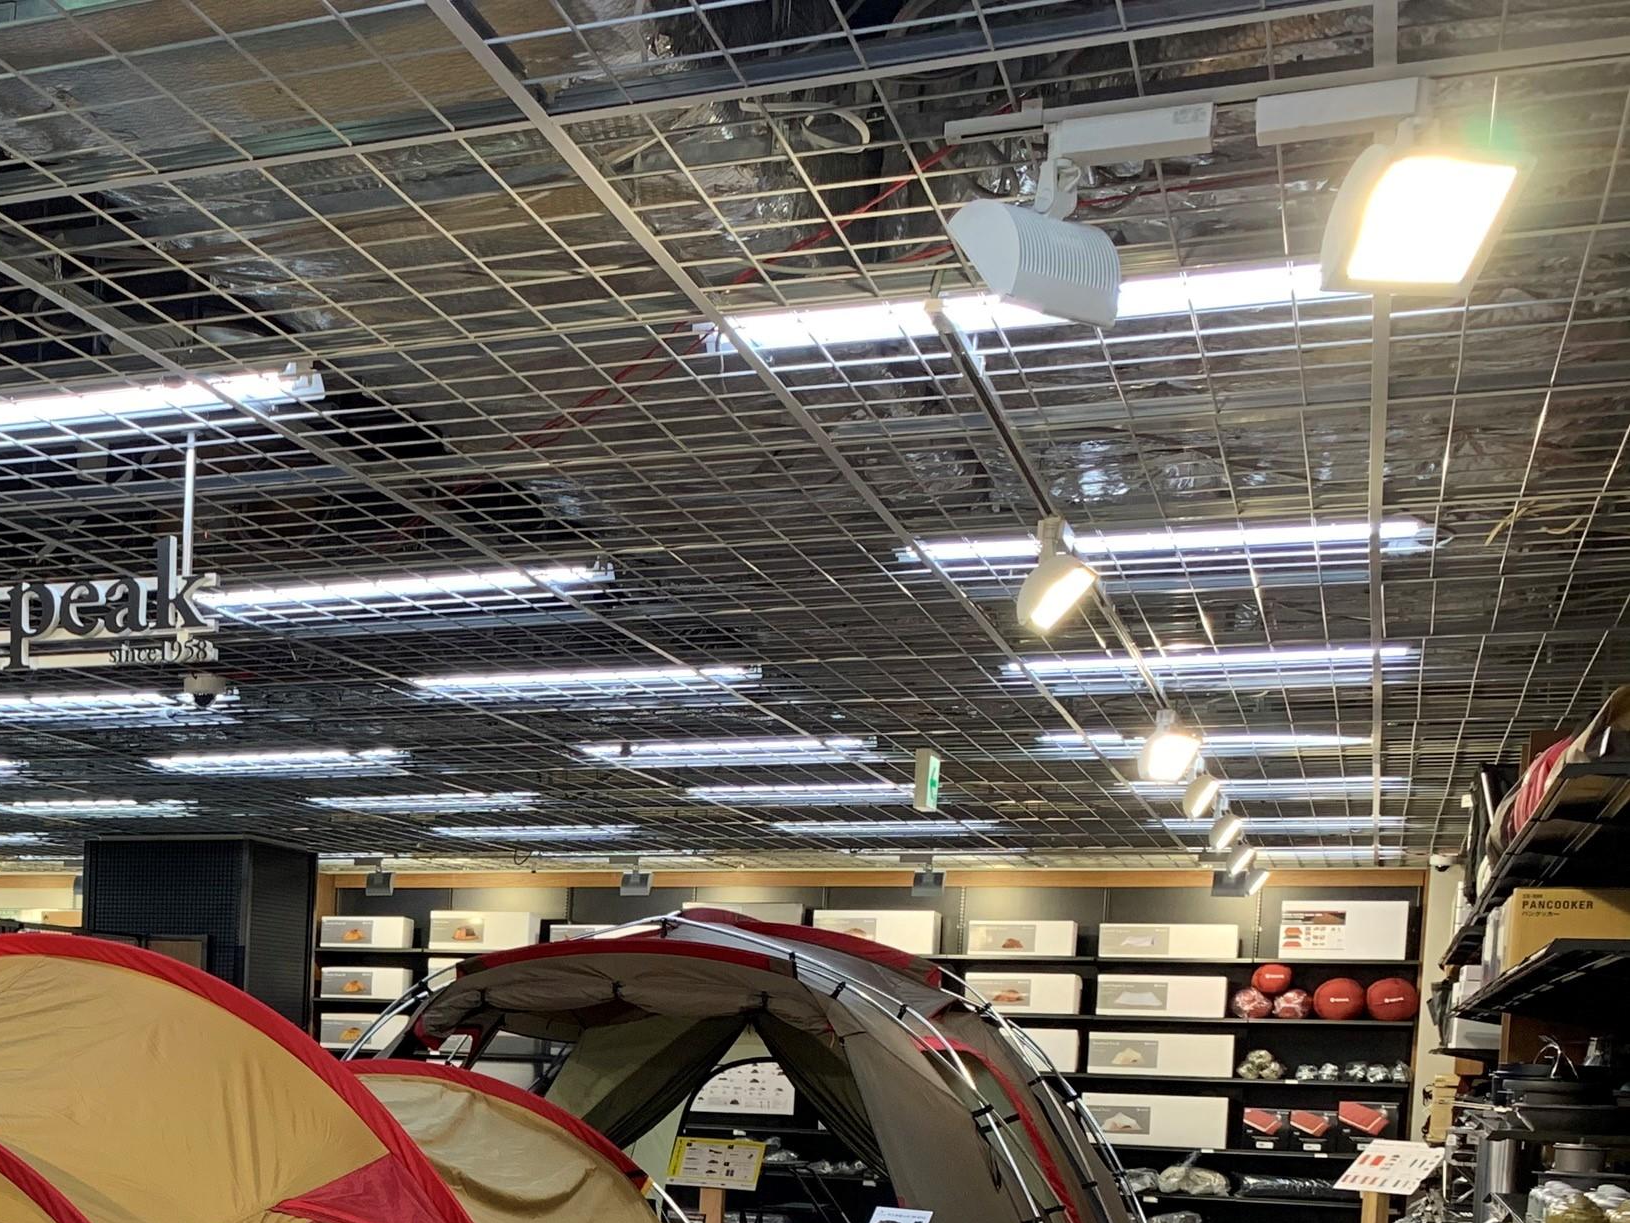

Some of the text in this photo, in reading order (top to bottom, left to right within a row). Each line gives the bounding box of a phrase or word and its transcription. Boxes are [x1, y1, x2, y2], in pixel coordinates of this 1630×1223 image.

[3, 536, 214, 668] peak
[108, 637, 210, 663] since 1958
[1521, 900, 1594, 910] PANCOOKER
